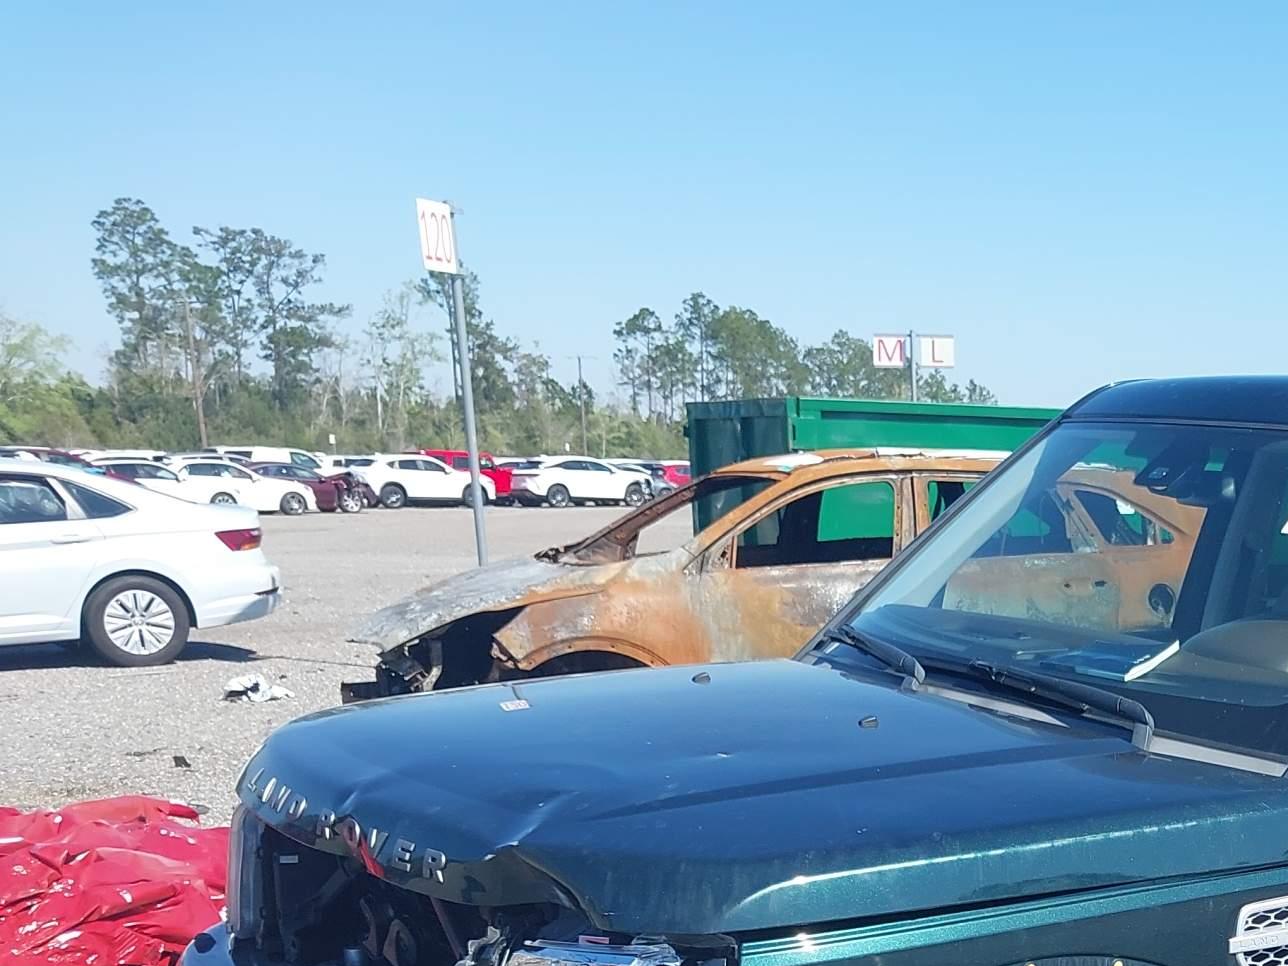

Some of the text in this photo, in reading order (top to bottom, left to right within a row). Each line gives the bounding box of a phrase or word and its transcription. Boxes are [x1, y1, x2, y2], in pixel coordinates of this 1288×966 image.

[420, 209, 452, 264] 120
[877, 338, 905, 362] M
[930, 339, 945, 364] L
[316, 808, 448, 884] ROVER
[1237, 934, 1279, 950] LAND
